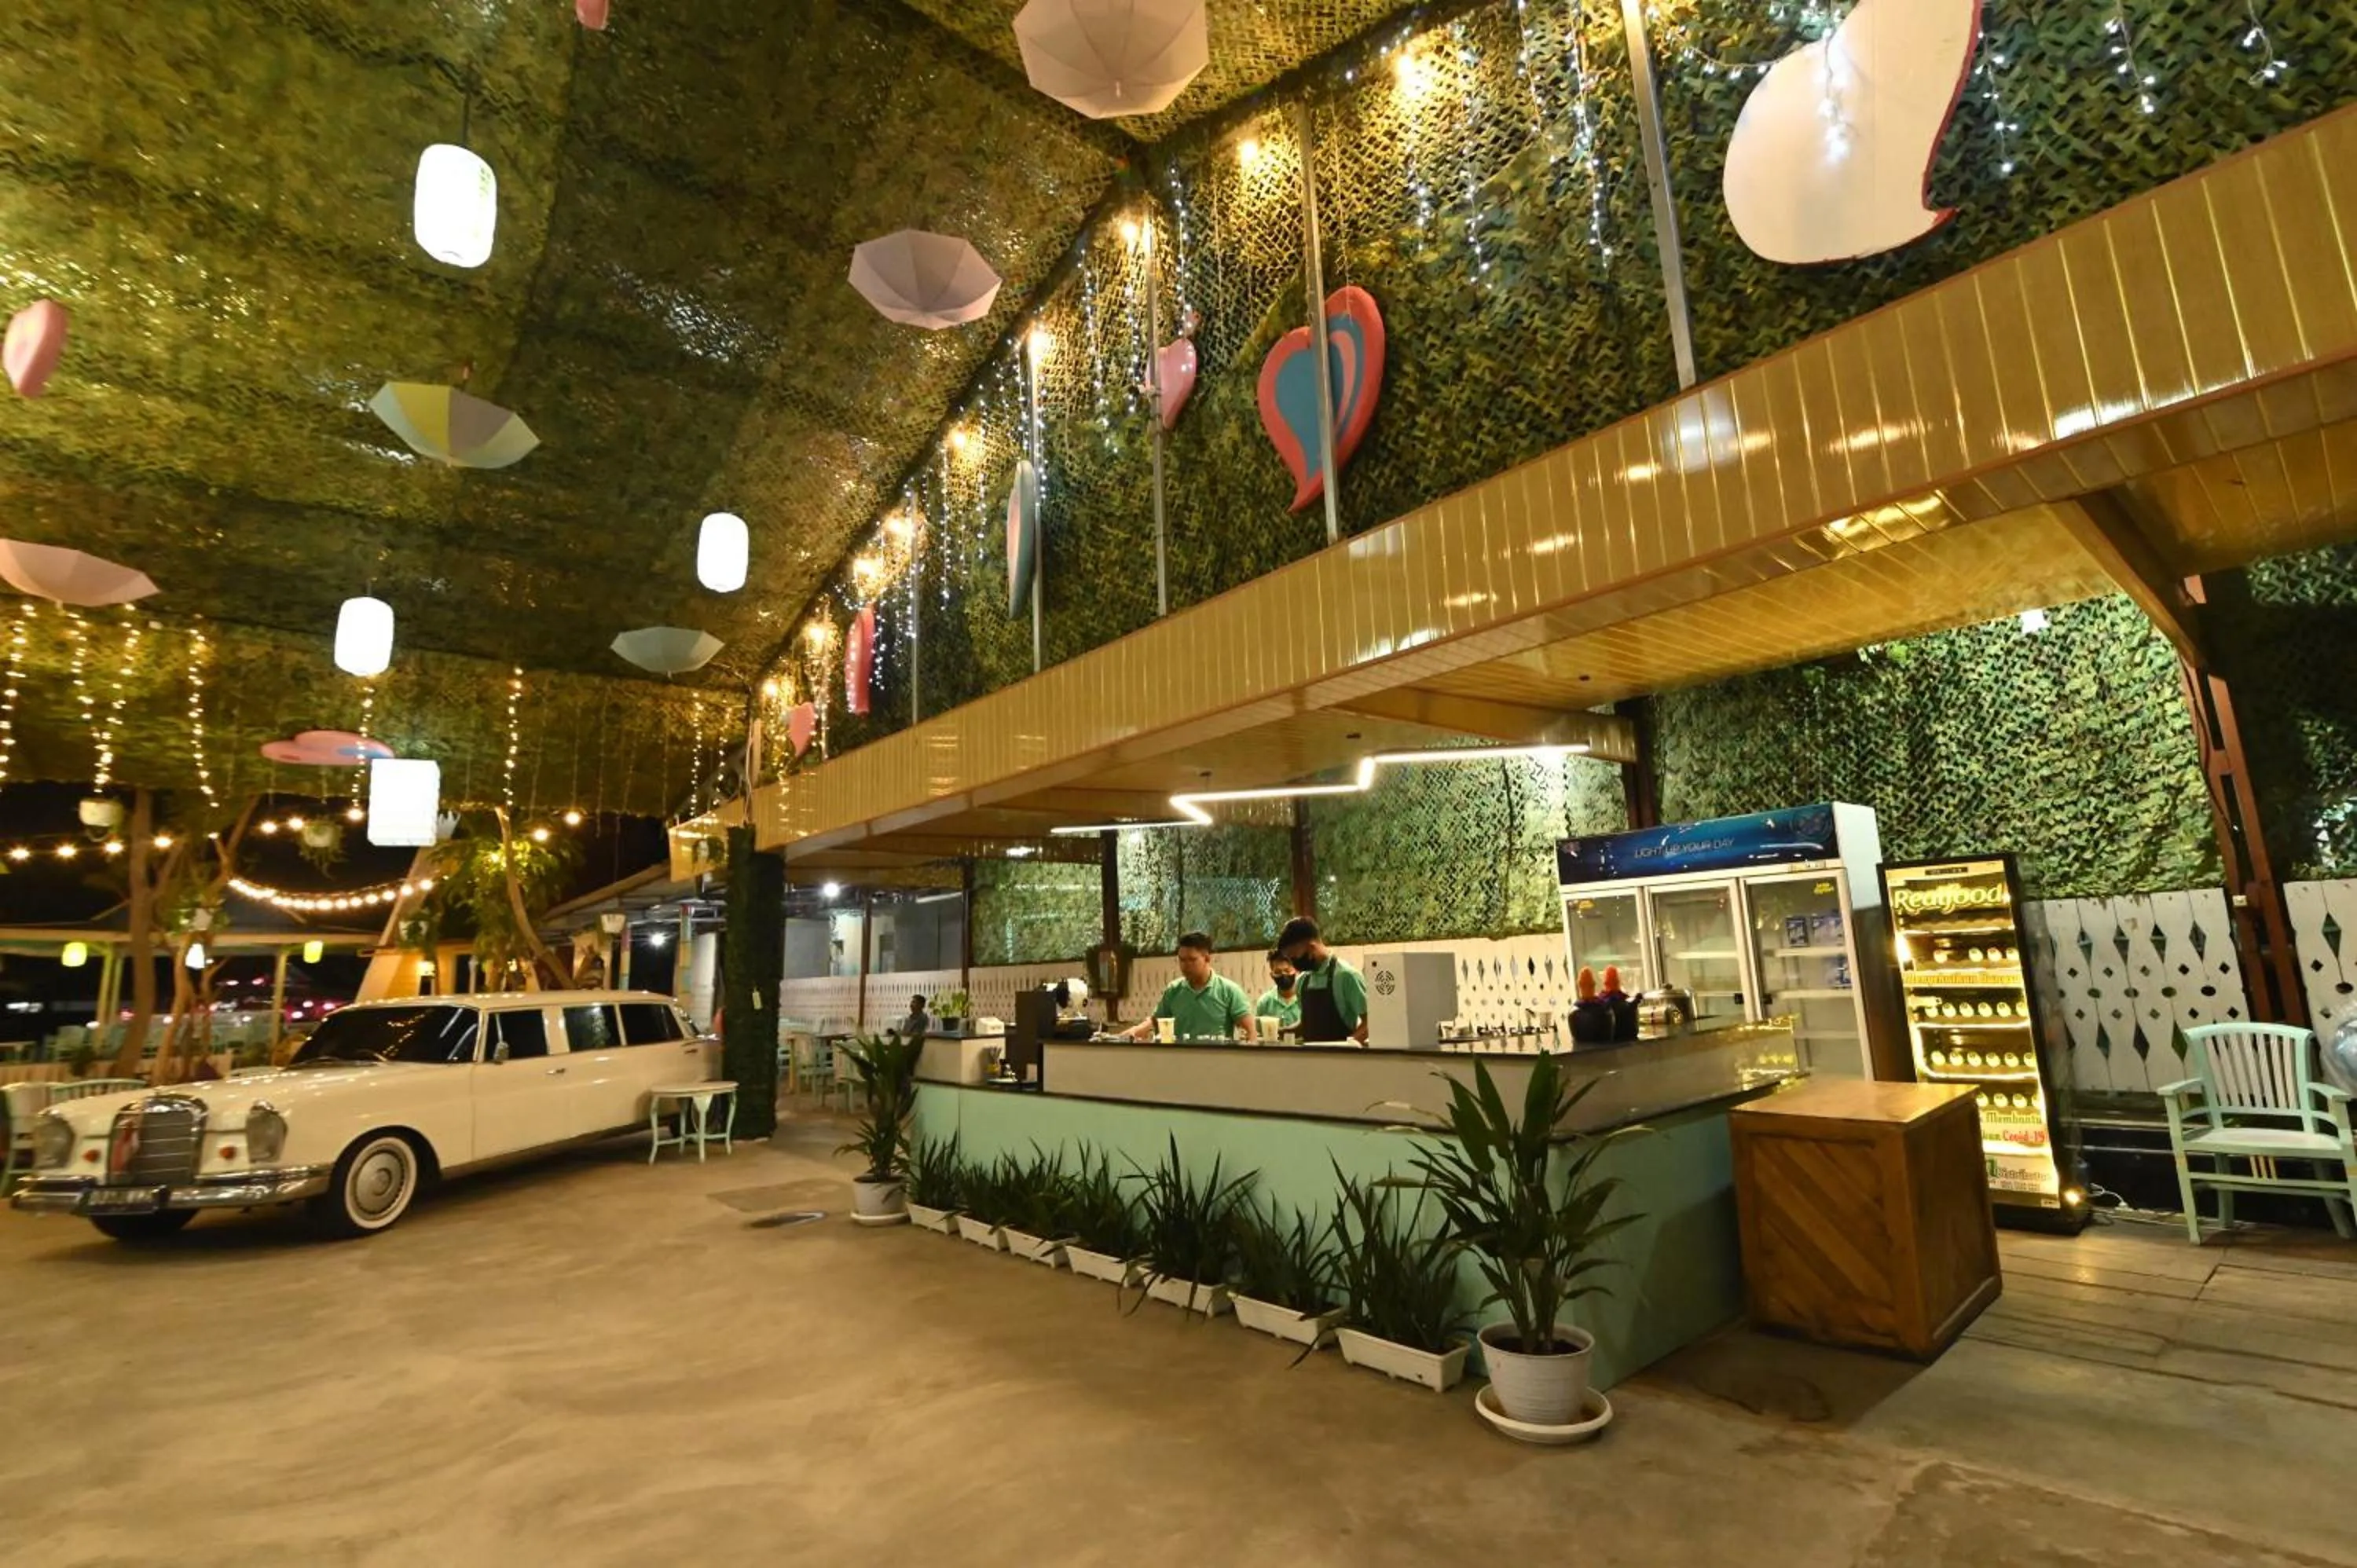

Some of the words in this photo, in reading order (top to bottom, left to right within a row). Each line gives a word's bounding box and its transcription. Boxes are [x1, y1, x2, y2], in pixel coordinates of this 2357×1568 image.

[1634, 845, 1664, 859] LIGHT
[1665, 843, 1681, 855] UP
[1683, 840, 1711, 853] YOUR
[1714, 837, 1735, 850] DAY
[1893, 884, 2003, 914] Realfood
